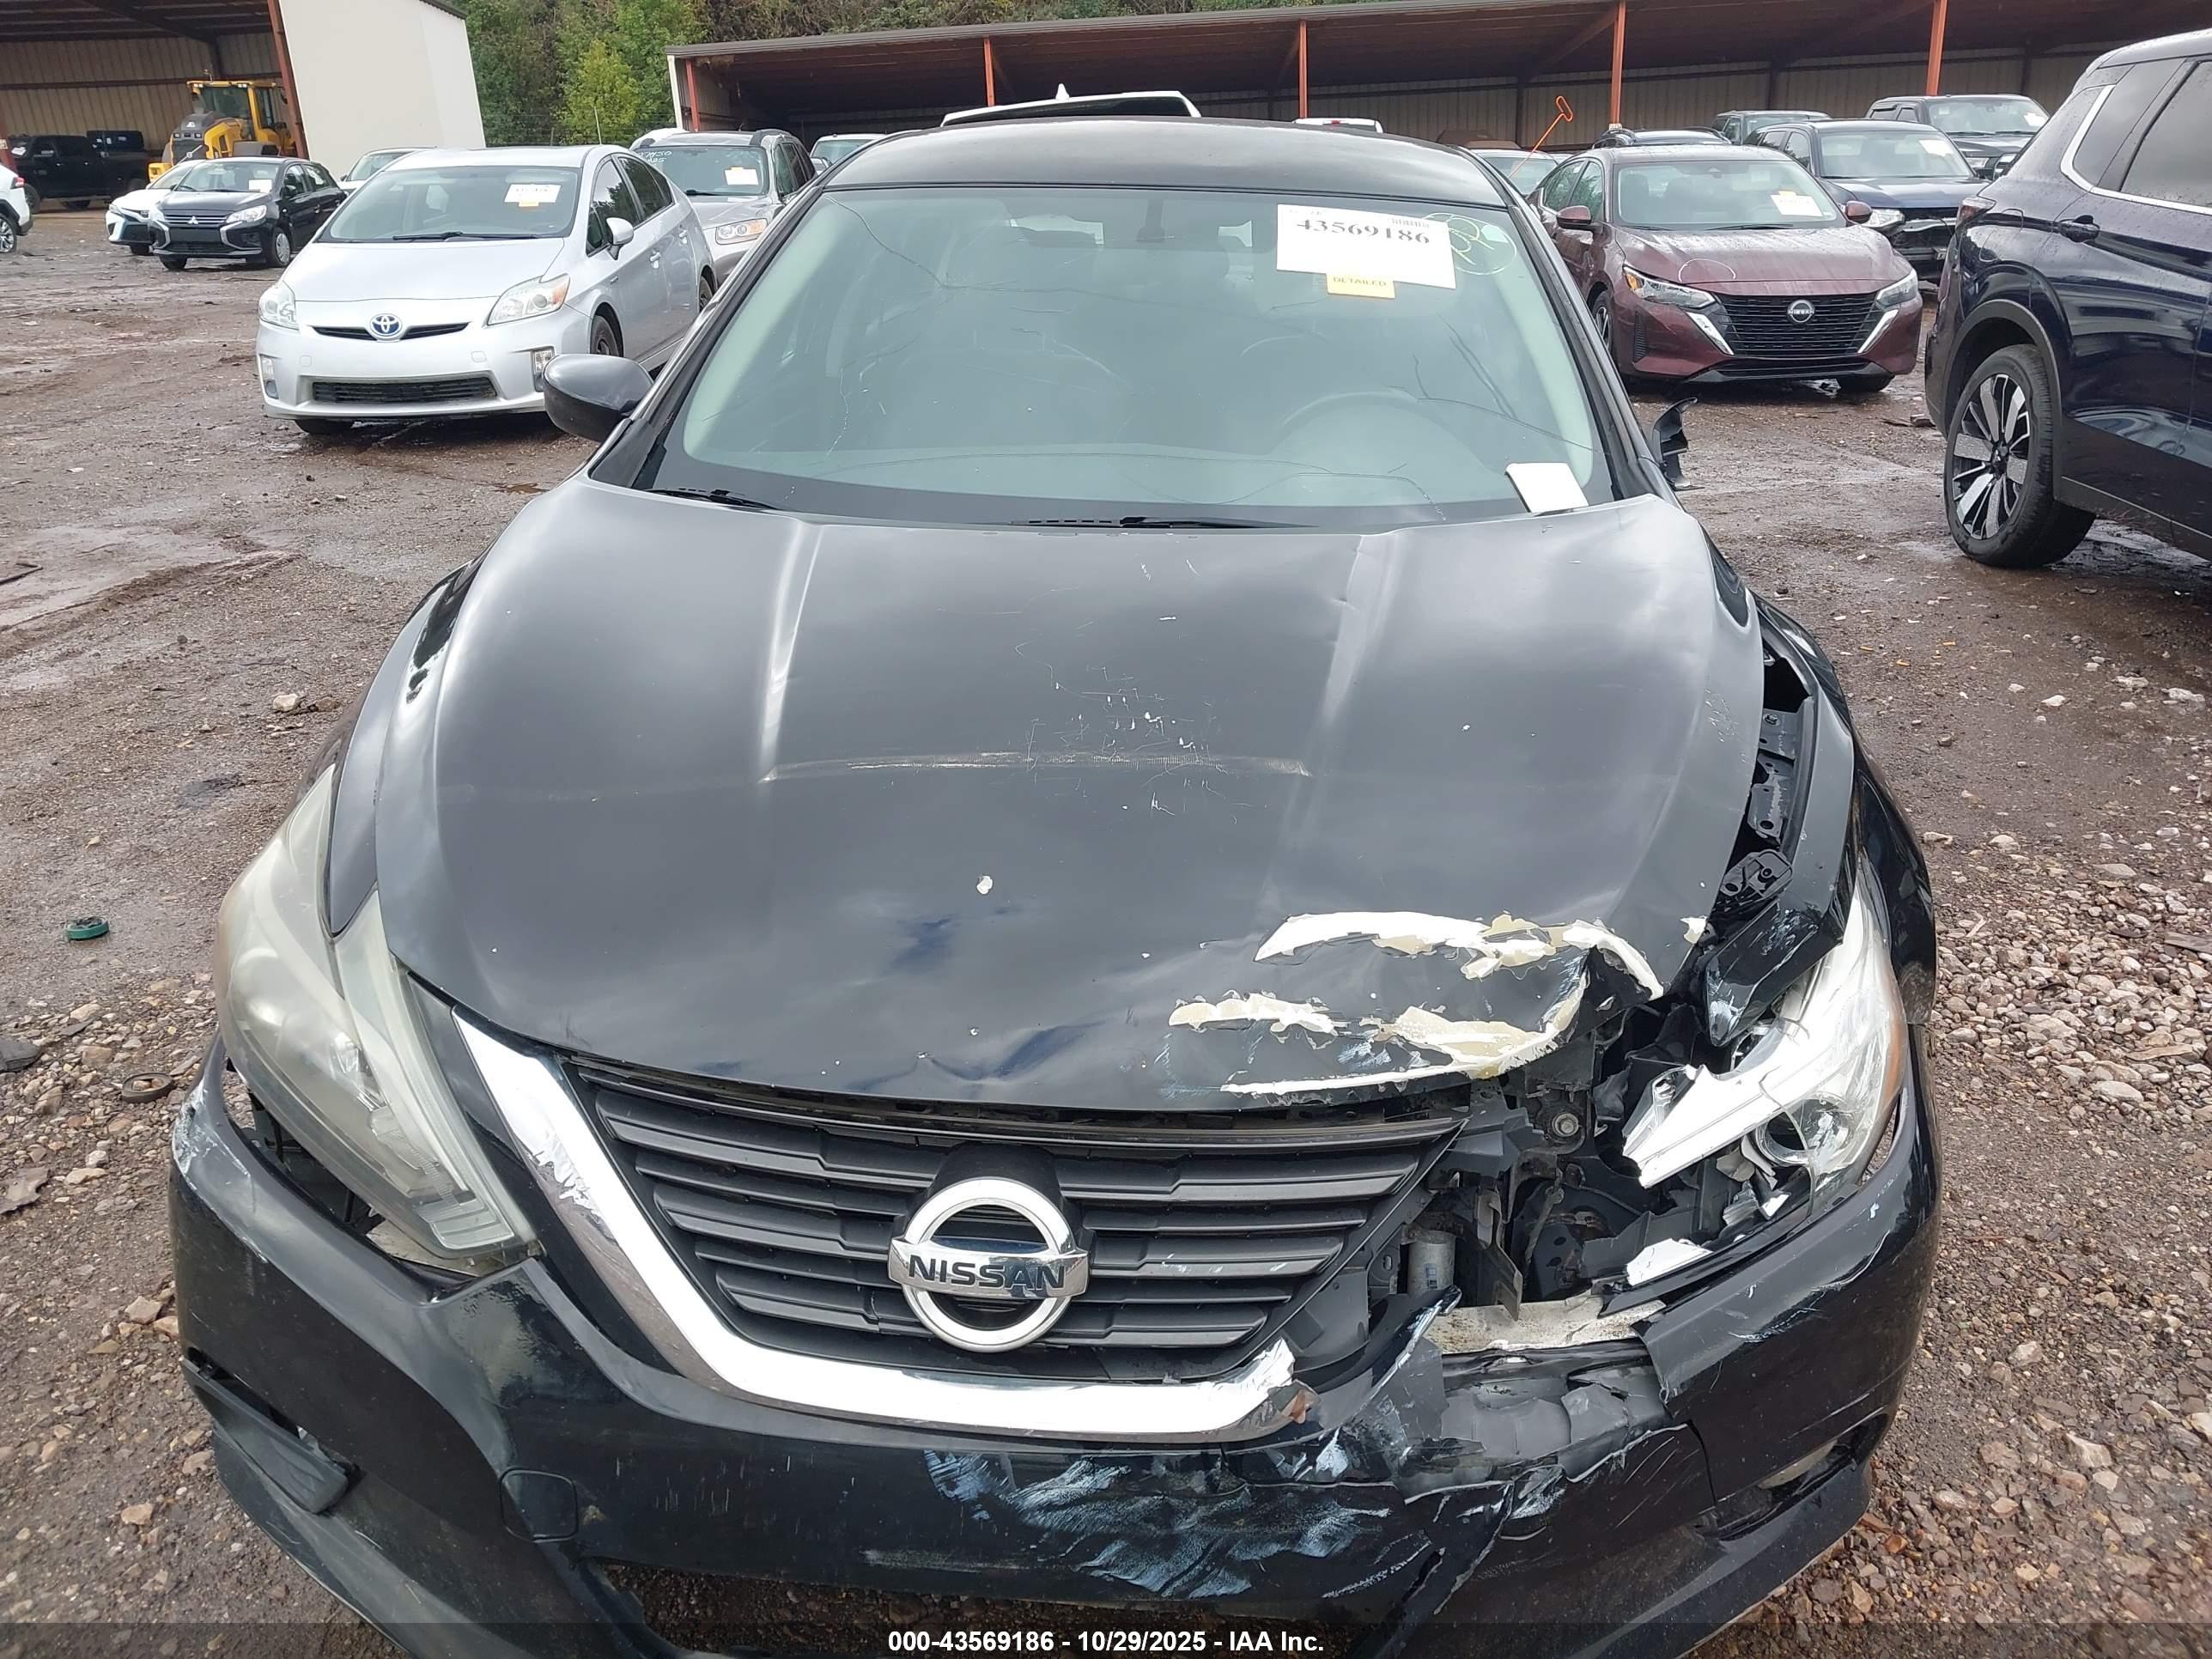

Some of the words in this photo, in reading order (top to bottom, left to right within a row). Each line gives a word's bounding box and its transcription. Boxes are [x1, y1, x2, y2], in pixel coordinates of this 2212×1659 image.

[1296, 219, 1431, 245] 43569186
[1333, 276, 1388, 287] DETAILED
[908, 1254, 1065, 1291] NISSAN
